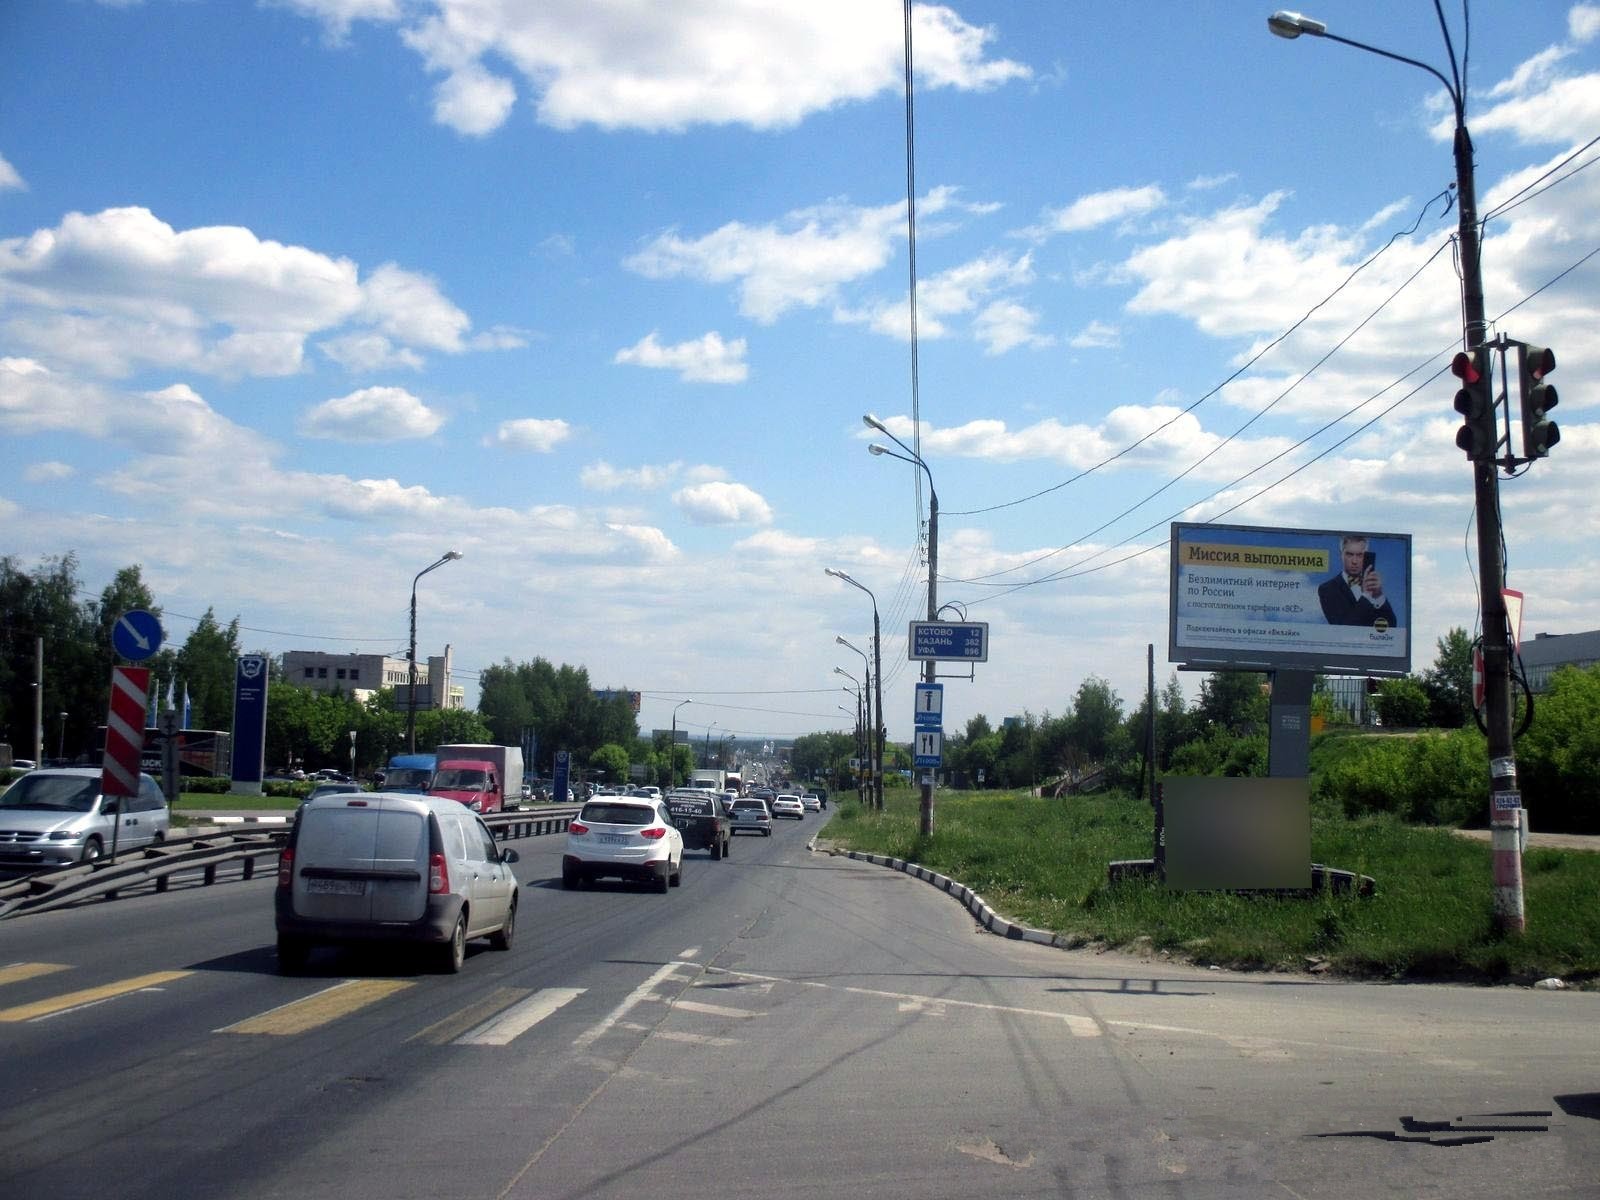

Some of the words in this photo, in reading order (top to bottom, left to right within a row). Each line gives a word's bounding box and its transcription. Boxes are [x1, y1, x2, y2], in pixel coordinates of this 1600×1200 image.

[1188, 546, 1240, 562] Миссия
[1244, 553, 1324, 568] выполнима
[1187, 573, 1254, 586] Безлимитный
[1256, 579, 1300, 591] интернет
[1187, 587, 1200, 597] по
[1202, 586, 1235, 597] России
[918, 628, 953, 636] КСТОВО
[970, 629, 980, 637] 12
[917, 637, 953, 646] КАЗАНЬ
[965, 638, 980, 646] 382
[917, 646, 936, 655] УФА
